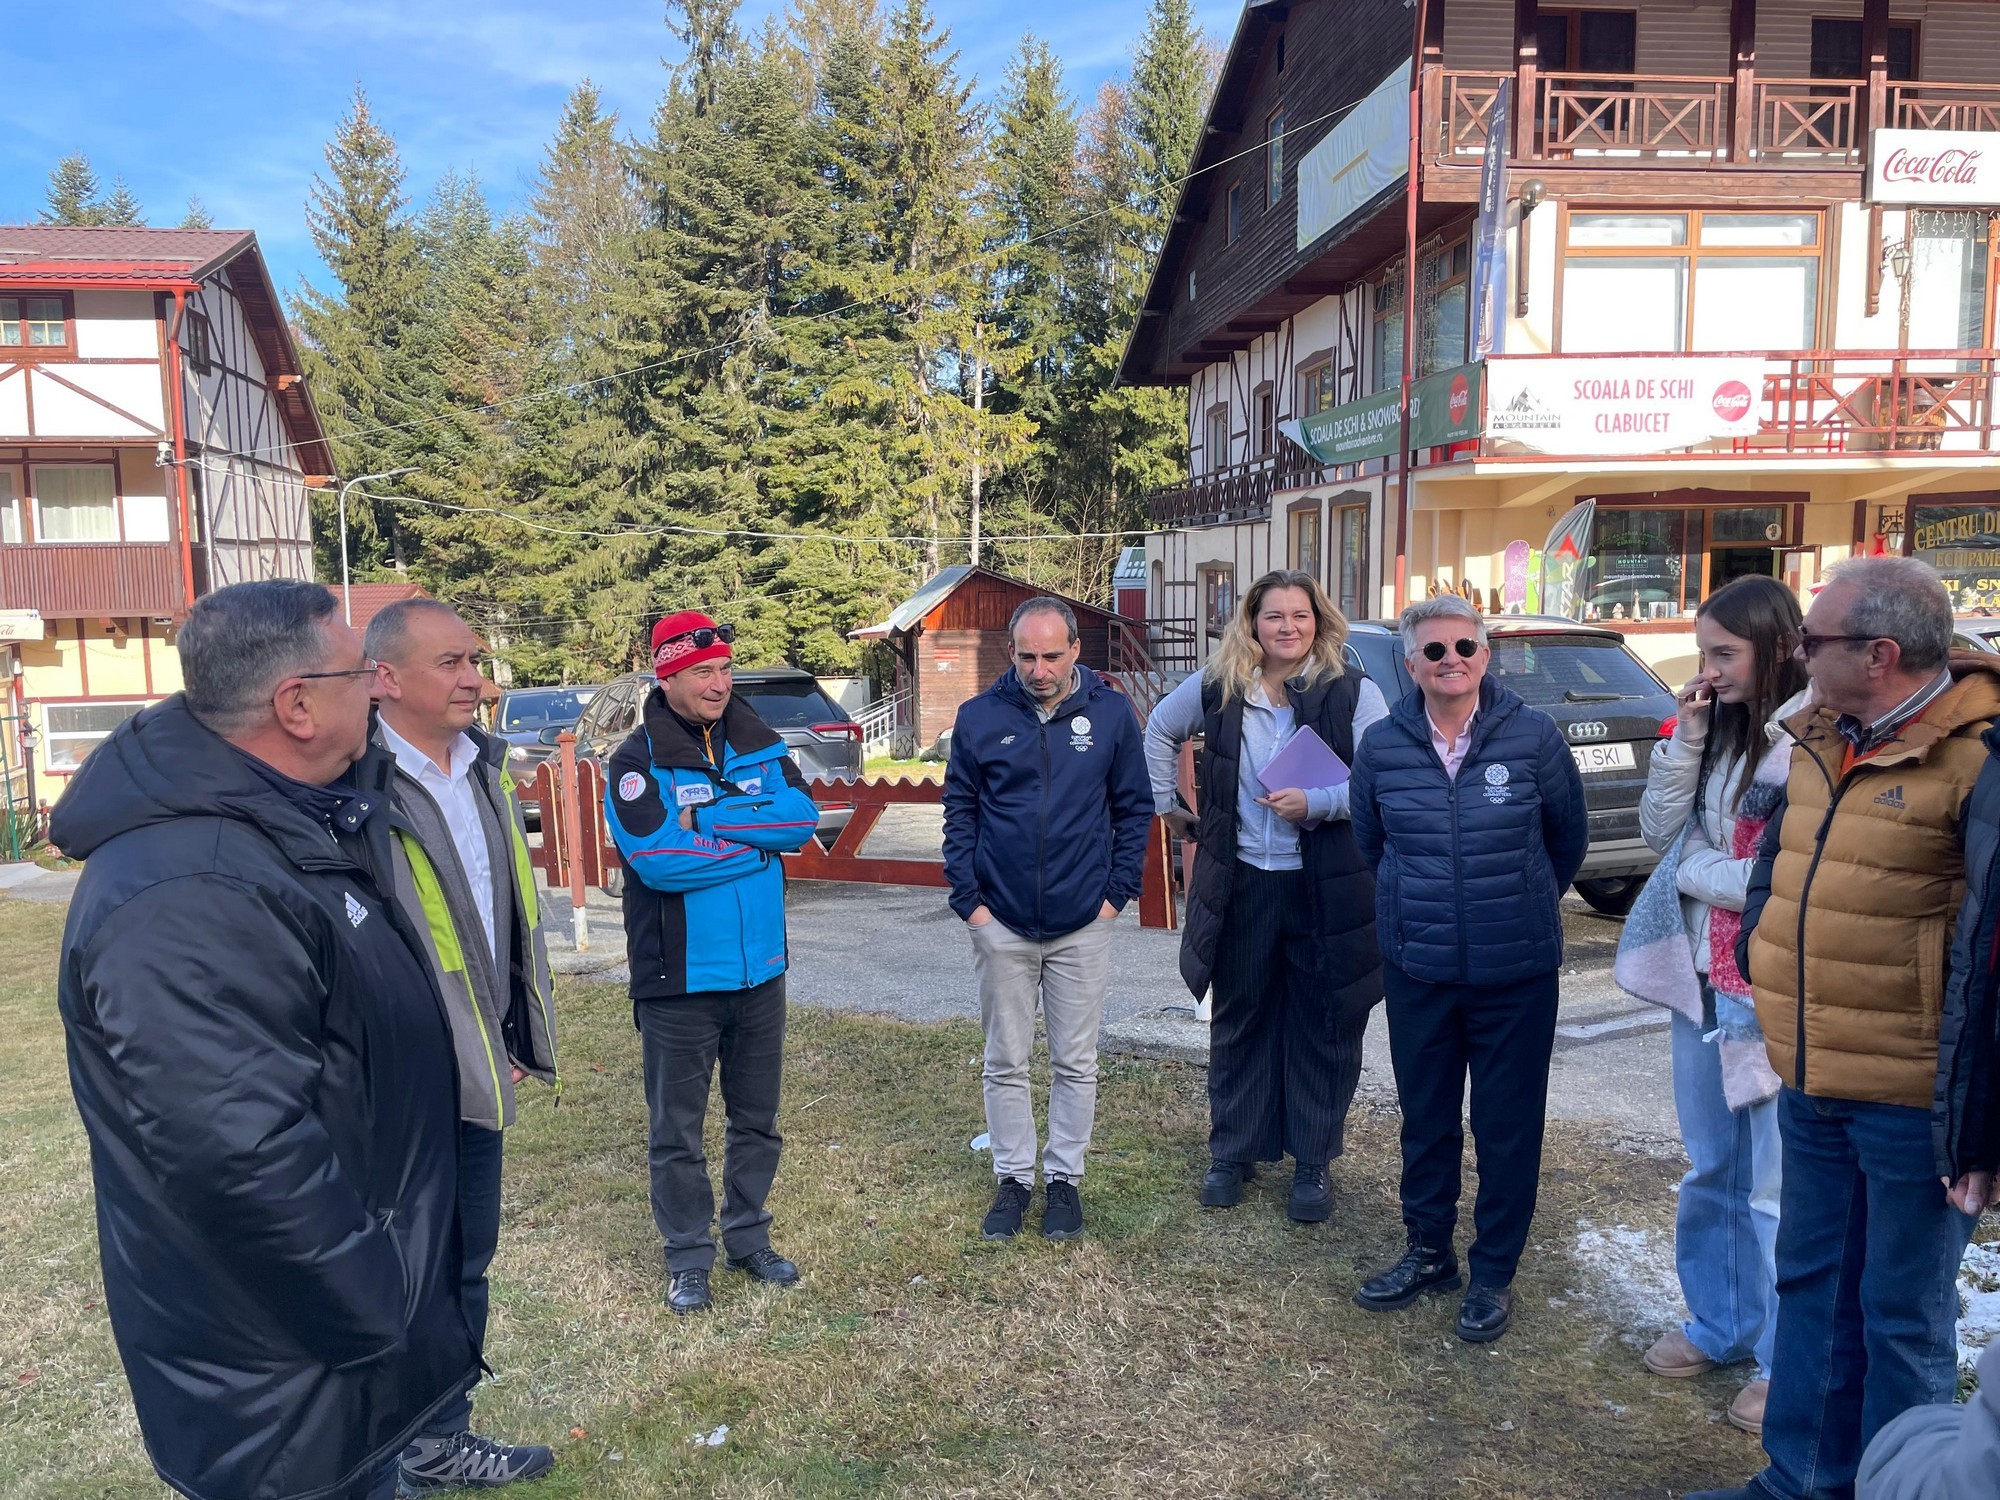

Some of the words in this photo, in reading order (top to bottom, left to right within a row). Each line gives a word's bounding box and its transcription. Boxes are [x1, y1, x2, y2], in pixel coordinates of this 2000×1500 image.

[1883, 148, 1983, 184] Coca-Cola
[1573, 379, 1630, 400] SCOALA
[1636, 379, 1655, 399] DE
[1660, 379, 1694, 399] SCHI
[1310, 423, 1334, 446] SCOALA
[1334, 420, 1343, 439] DE
[1344, 415, 1359, 436] SCHI
[1360, 413, 1367, 432] &
[1367, 398, 1420, 429] SNOWBORD
[1493, 413, 1560, 422] MOUNTAIN
[1595, 412, 1670, 433] CLABUCET
[1914, 514, 1979, 552] CENTRU
[1941, 580, 1960, 591] KI
[1000, 735, 1016, 745] 4F
[1592, 747, 1621, 766] SKI
[1873, 796, 1906, 809] adidas
[351, 905, 369, 928] adidas
